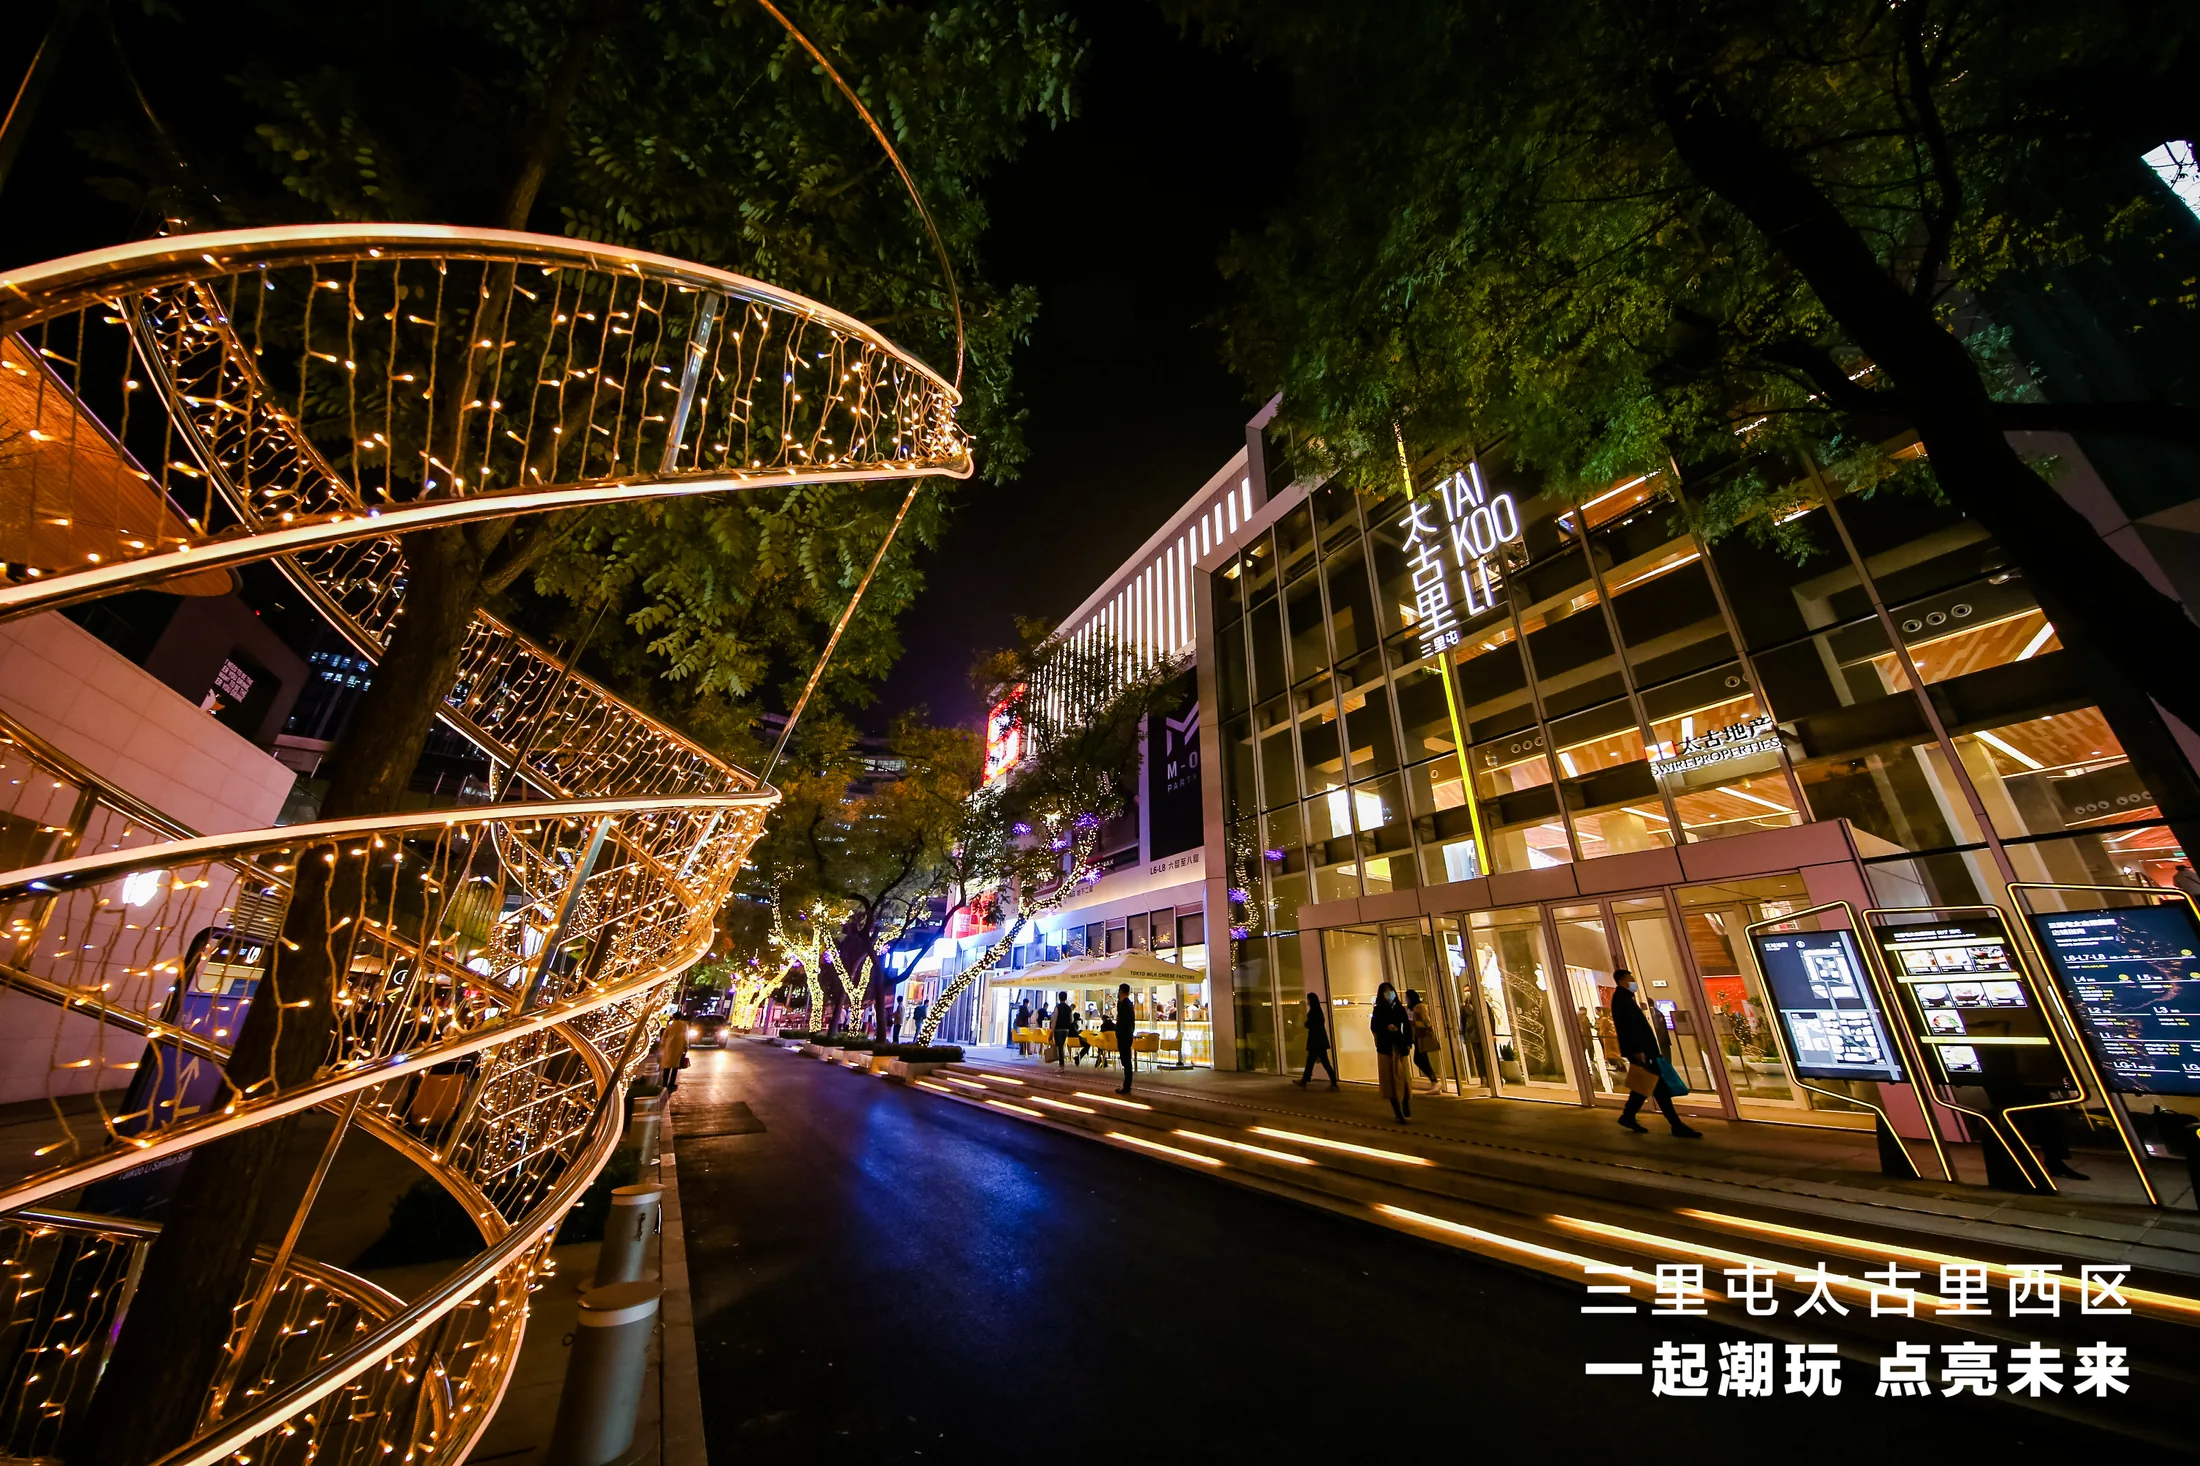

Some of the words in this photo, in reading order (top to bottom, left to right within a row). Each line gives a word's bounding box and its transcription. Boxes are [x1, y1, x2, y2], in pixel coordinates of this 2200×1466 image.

[1435, 462, 1483, 522] TAI
[1451, 493, 1519, 567] KOO
[1398, 500, 1457, 641] 太古里
[1460, 558, 1494, 617] LI
[1420, 630, 1459, 659] 三里屯
[1677, 715, 1774, 756] 太古地产
[1167, 774, 1198, 793] PARTY
[1150, 863, 1166, 876] L6-L8
[1168, 853, 1200, 870] 六层至八层
